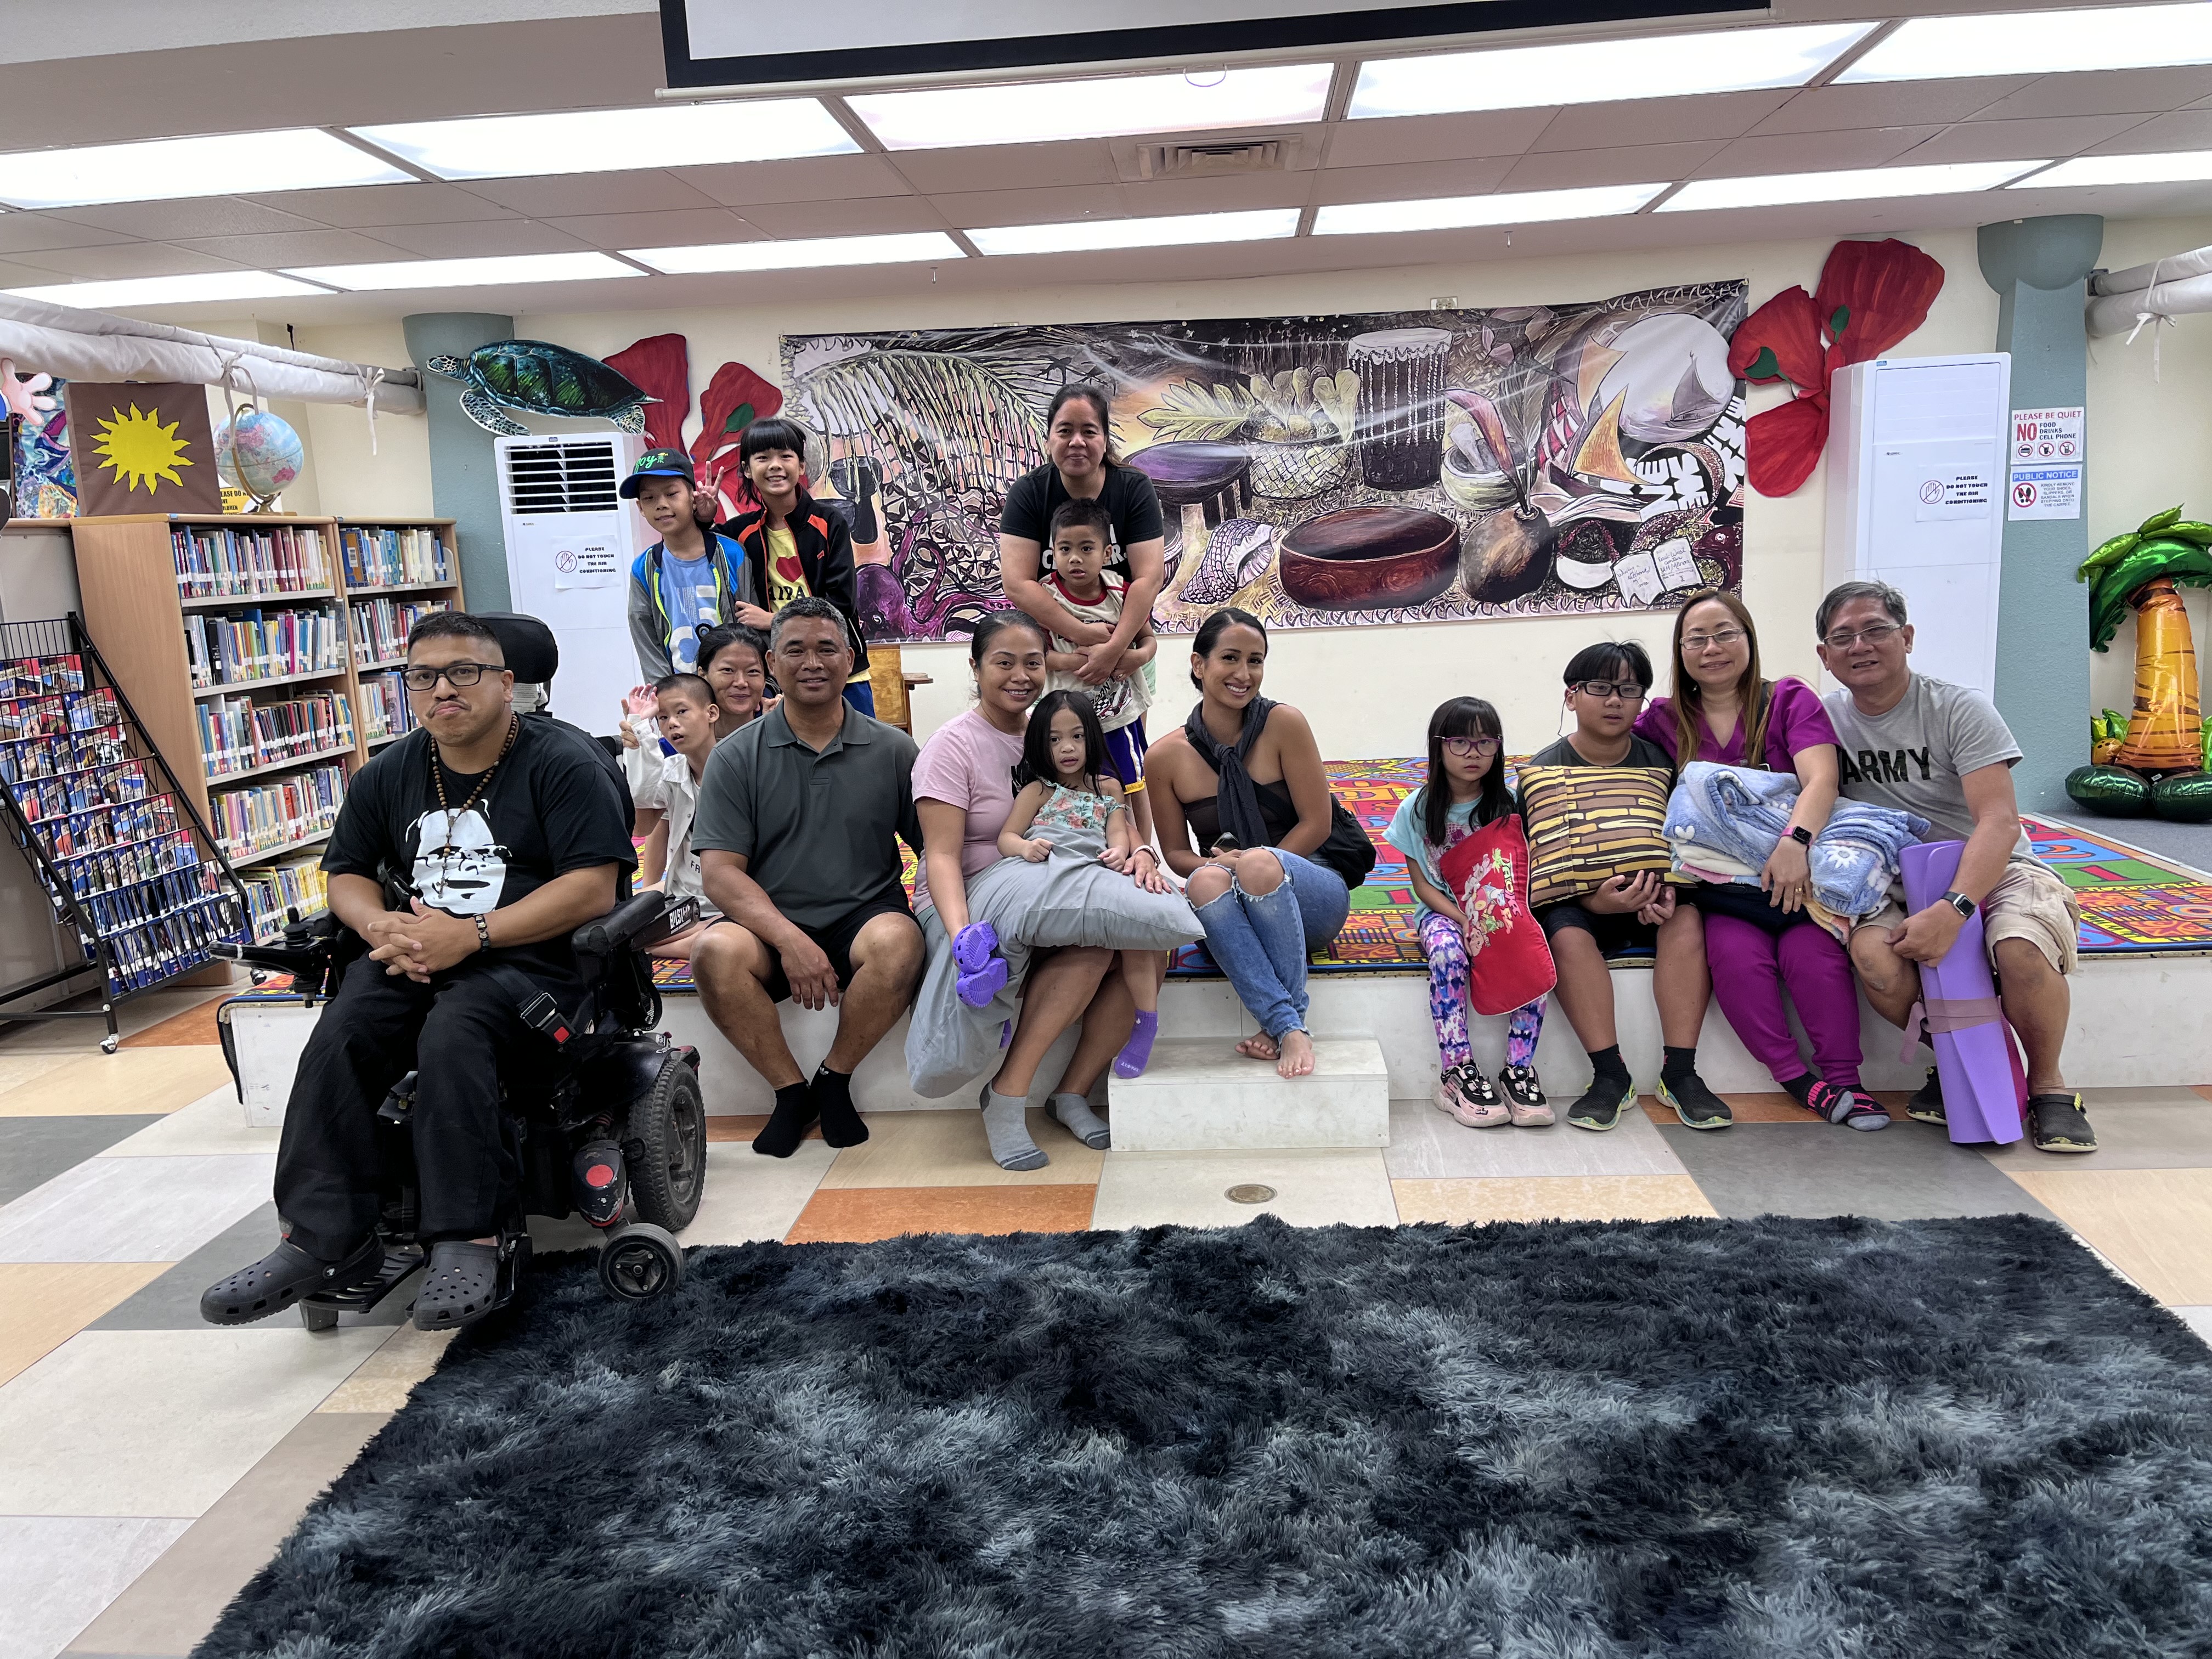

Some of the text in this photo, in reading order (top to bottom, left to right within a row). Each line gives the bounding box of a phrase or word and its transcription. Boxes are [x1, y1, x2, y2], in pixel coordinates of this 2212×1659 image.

[2014, 412, 2042, 421] PLEASE
[2017, 422, 2037, 441] NO
[2013, 470, 2077, 481] PUBLIC NOTICE
[76, 695, 103, 707] MICIGAN
[1842, 747, 1931, 785] ARMY
